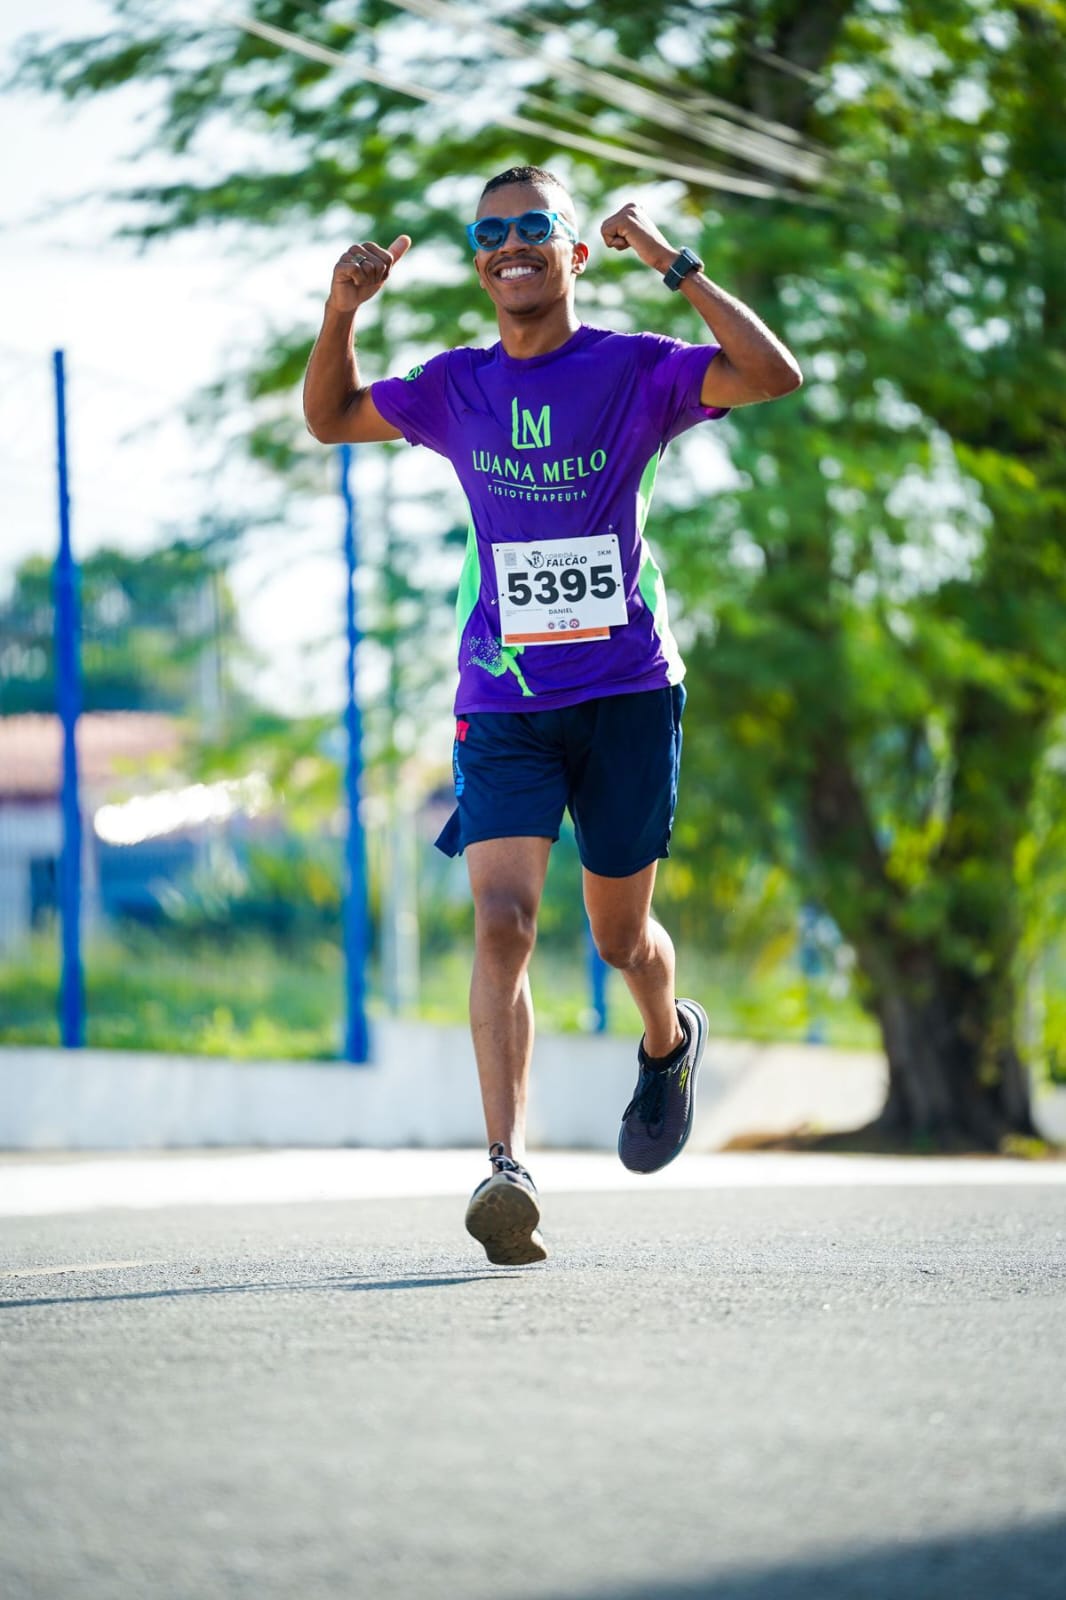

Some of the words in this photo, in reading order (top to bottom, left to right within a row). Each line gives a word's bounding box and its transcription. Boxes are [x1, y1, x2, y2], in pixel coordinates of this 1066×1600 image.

[472, 450, 536, 483] LUANA
[543, 449, 607, 483] MELO
[487, 485, 588, 503] FISIOTERAPEUTA
[546, 554, 588, 568] FALCÃO
[507, 565, 617, 606] 5395
